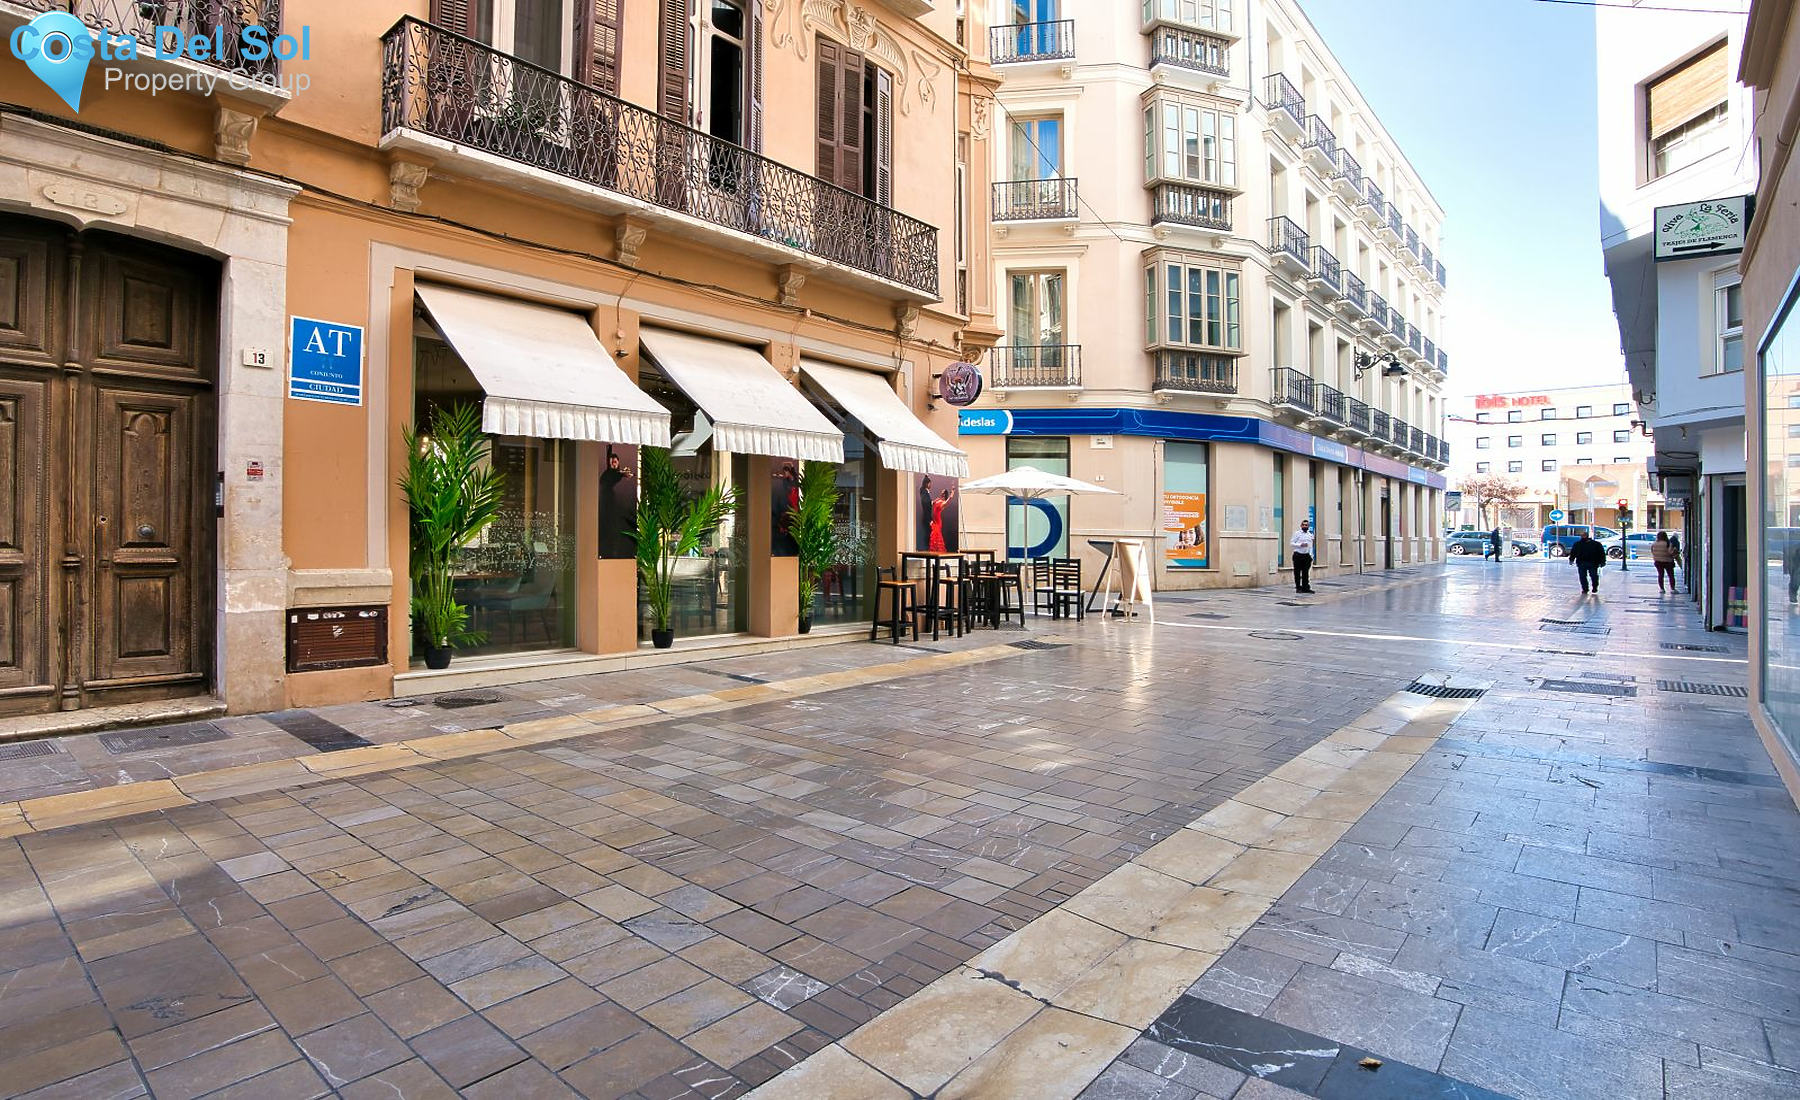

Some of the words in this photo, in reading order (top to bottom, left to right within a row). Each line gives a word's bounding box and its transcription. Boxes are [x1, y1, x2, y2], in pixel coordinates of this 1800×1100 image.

[1662, 213, 1684, 233] Viva
[1716, 204, 1740, 225] Feria
[1662, 239, 1686, 247] TRAJES
[1698, 233, 1738, 242] FLAMENCA
[303, 326, 352, 358] AT
[252, 352, 265, 365] 13
[309, 383, 344, 393] CIUDAD
[1511, 395, 1552, 407] HOTEL
